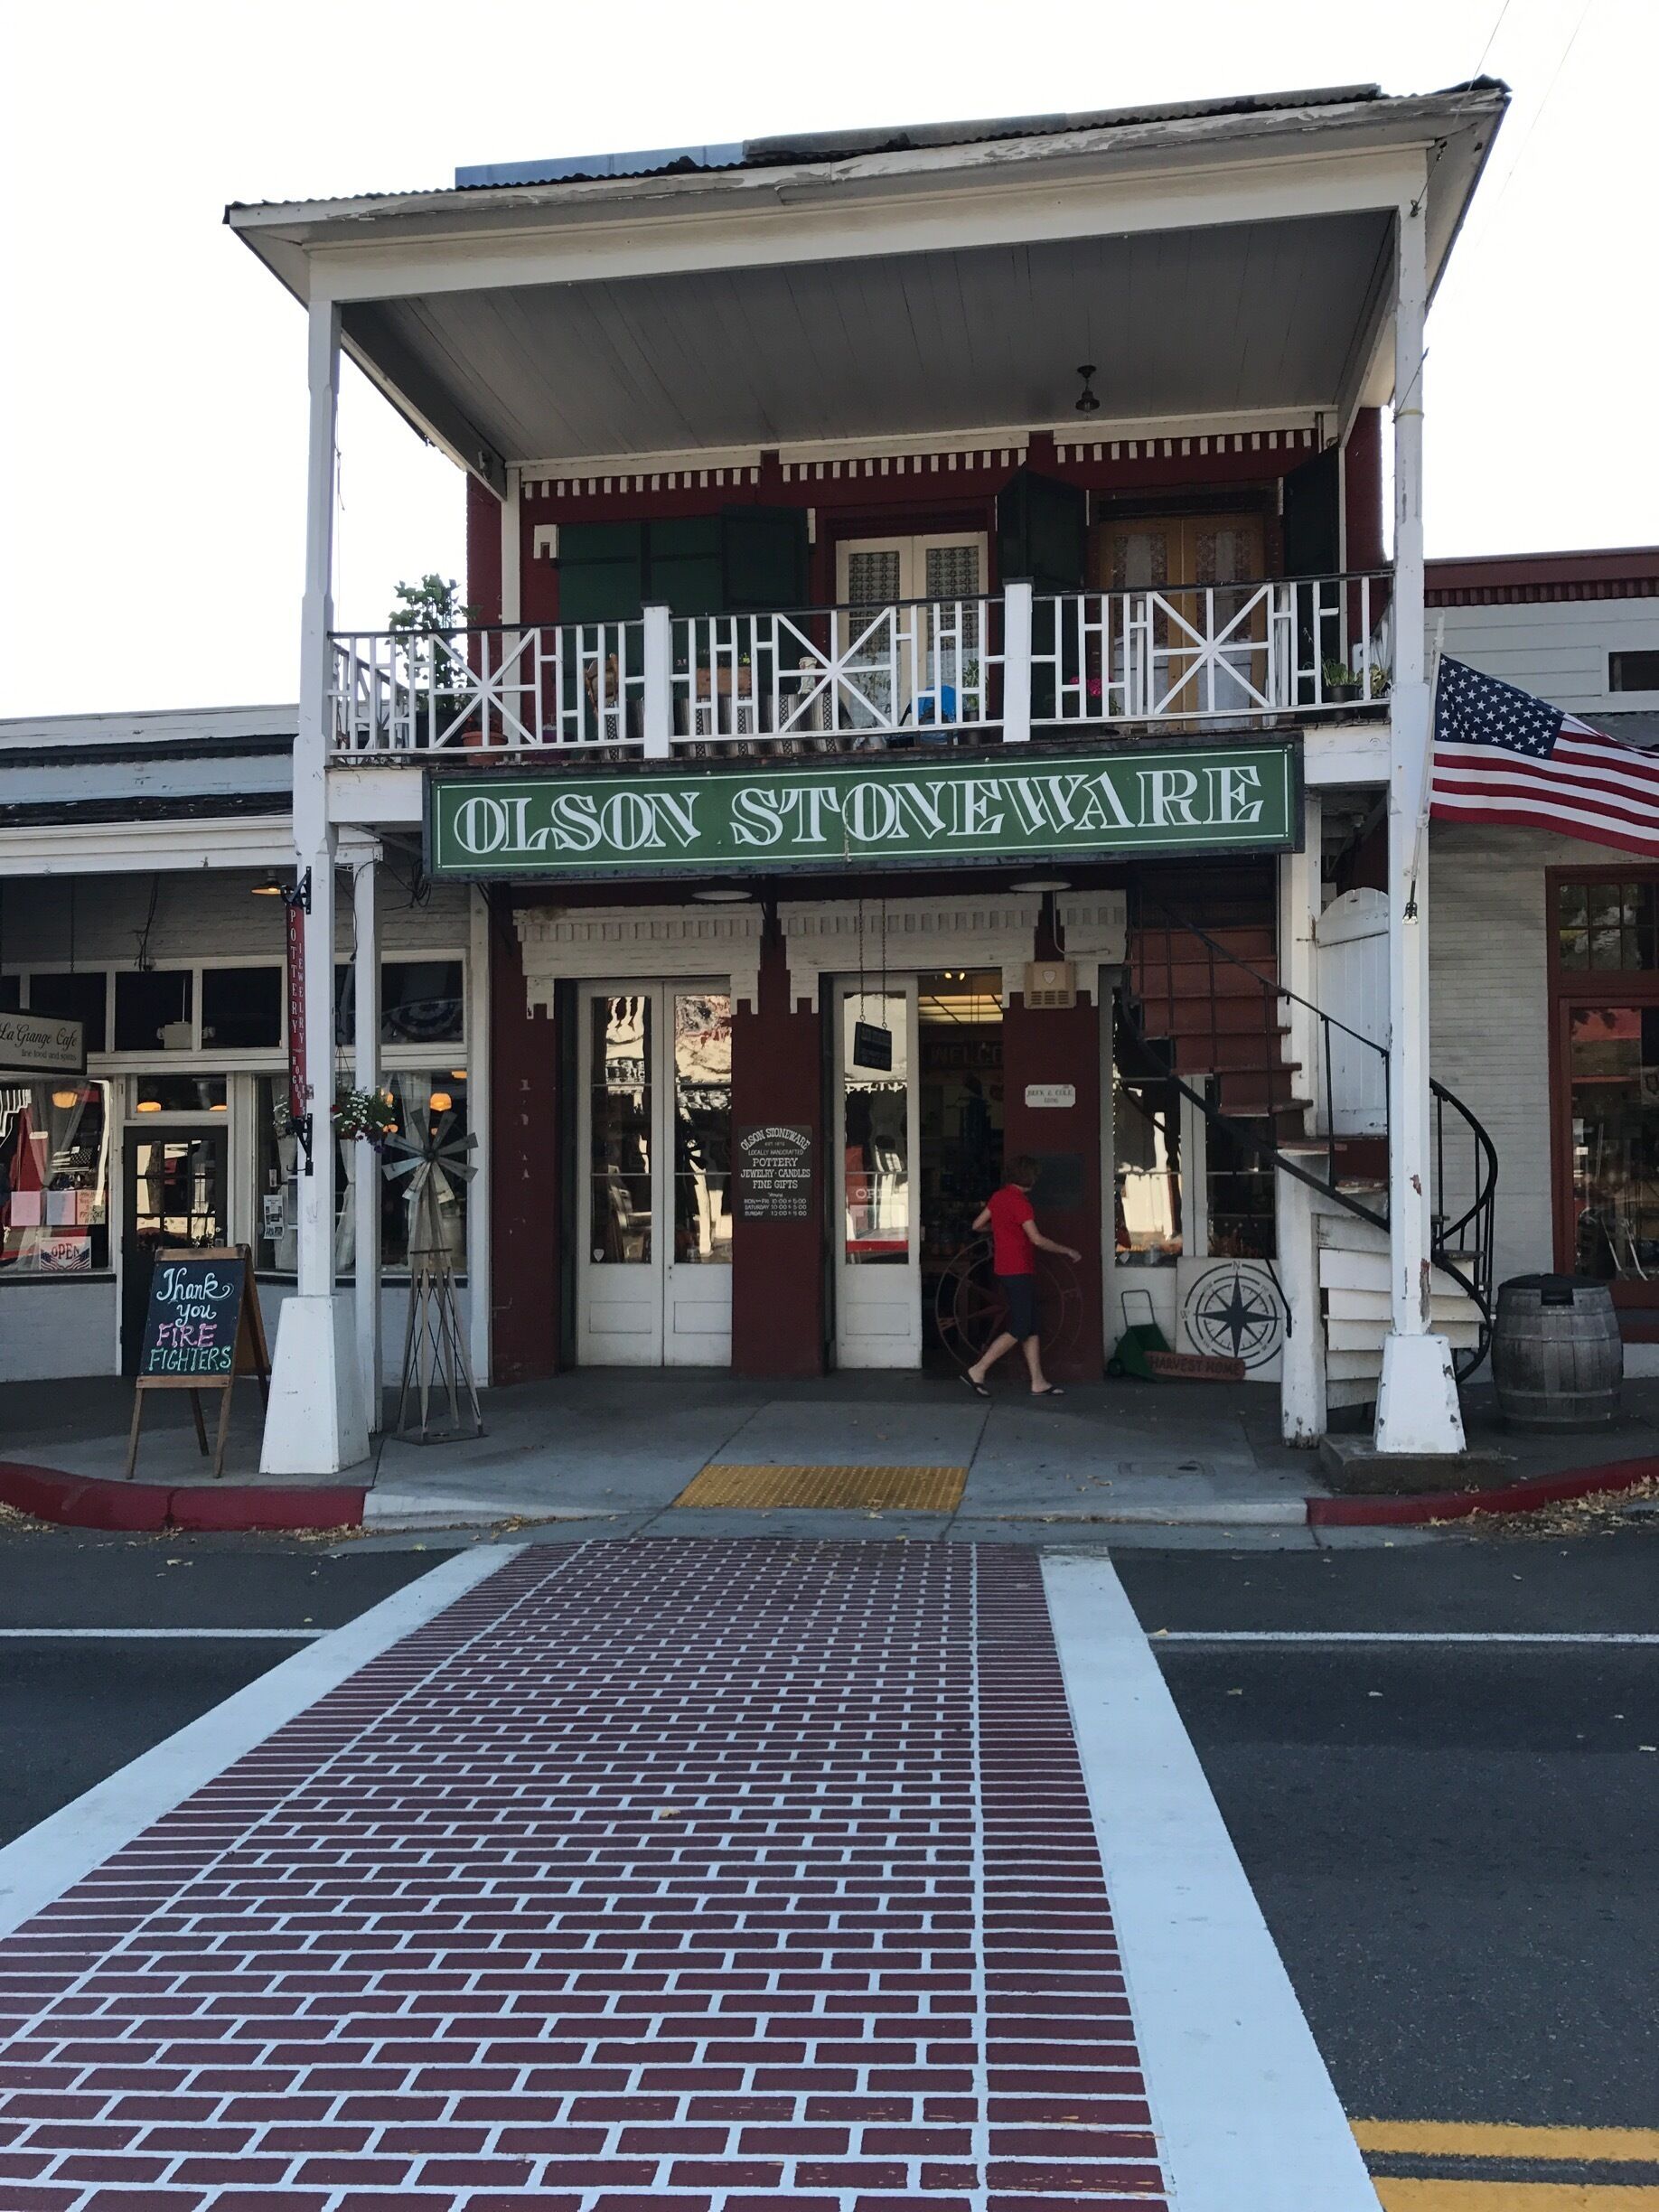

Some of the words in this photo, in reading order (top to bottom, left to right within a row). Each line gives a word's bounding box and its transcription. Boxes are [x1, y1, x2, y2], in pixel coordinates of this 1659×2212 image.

[454, 792, 701, 854] OLSON
[729, 765, 1264, 846] STONEWARE
[14, 1024, 52, 1049] Grange
[741, 1129, 765, 1150] OLSON
[765, 1128, 811, 1150] STONEWARE
[741, 1168, 774, 1178] JEWELRY
[778, 1168, 811, 1178] CANDLES
[753, 1158, 798, 1167] POTTERY
[753, 1180, 772, 1189] FINE
[773, 1180, 798, 1189] GIFTS
[52, 1243, 80, 1260] OPEN
[1233, 1261, 1241, 1270] N
[156, 1267, 234, 1304] Thank
[175, 1304, 217, 1327] you
[156, 1323, 217, 1348] FIRE
[148, 1345, 231, 1372] FIGHTERS
